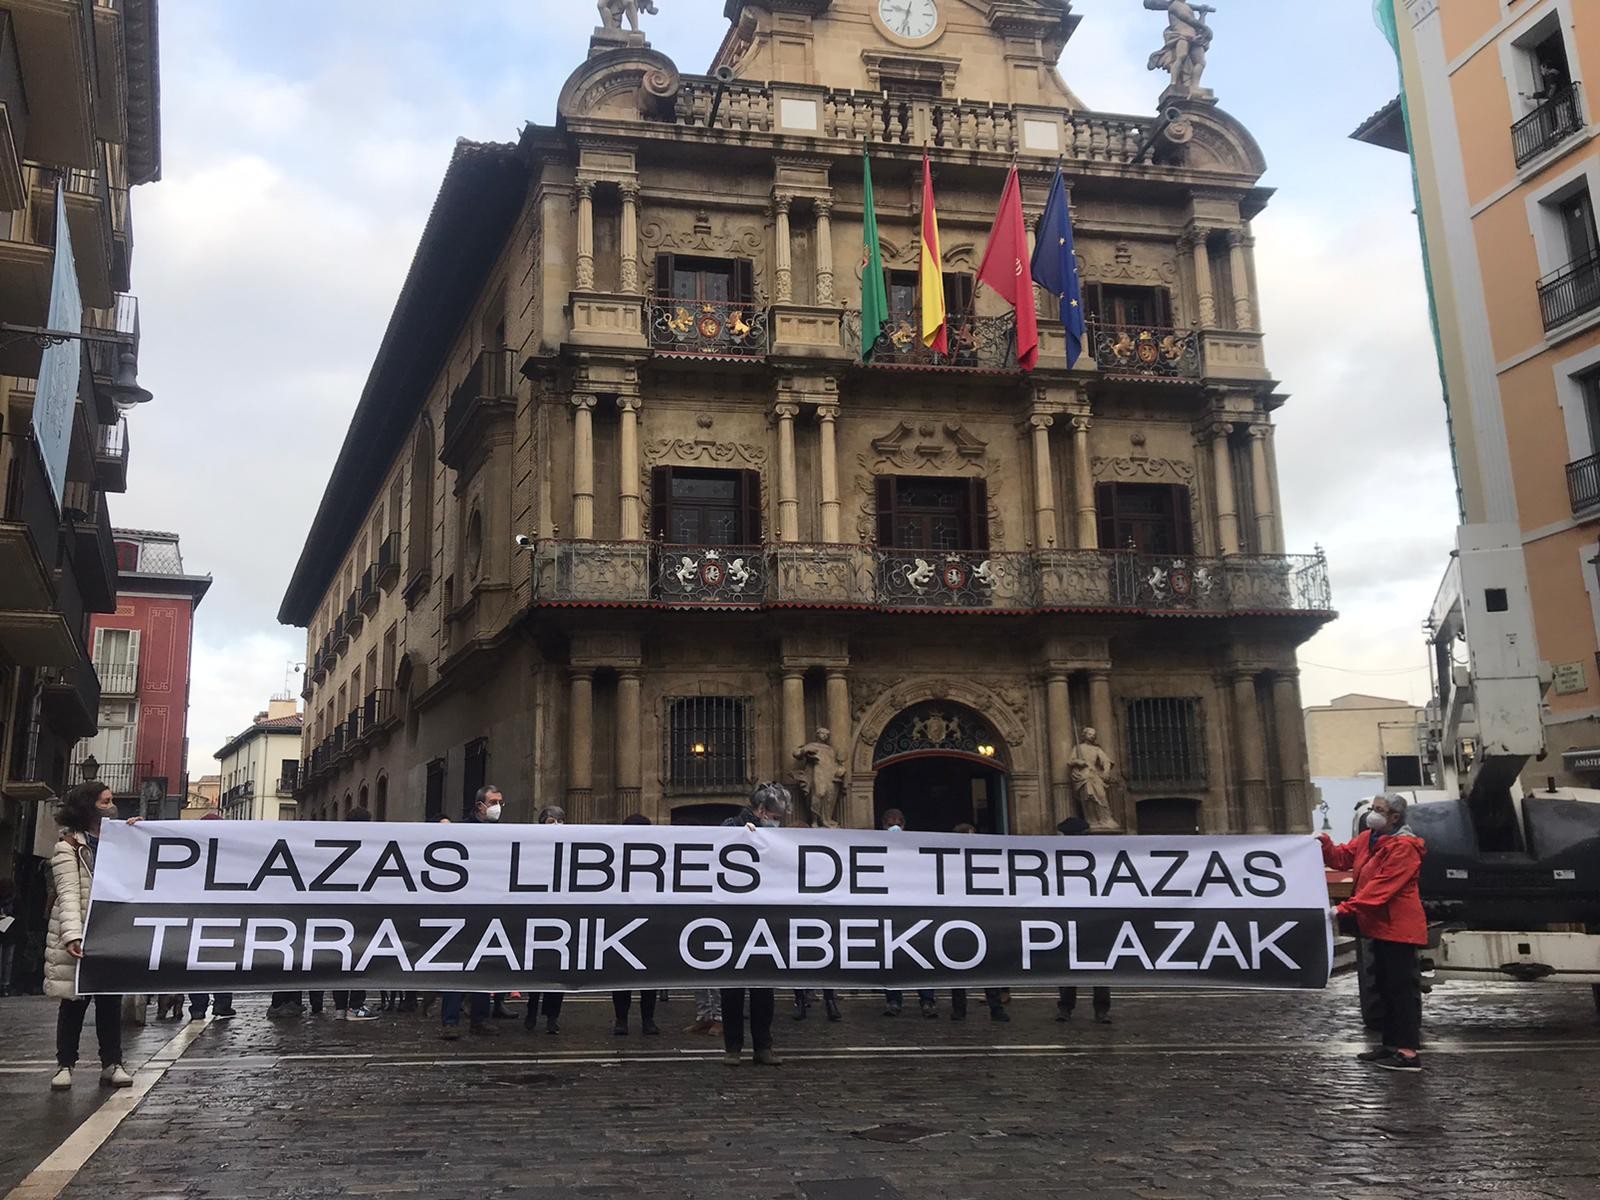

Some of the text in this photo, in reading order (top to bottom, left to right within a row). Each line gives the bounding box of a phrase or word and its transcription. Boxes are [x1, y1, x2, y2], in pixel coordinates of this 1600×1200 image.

[144, 836, 1287, 898] PLAZAS LIBRES DE TERRAZAS
[132, 916, 1301, 972] TERRAZARIK GABEKO PLAZAK
